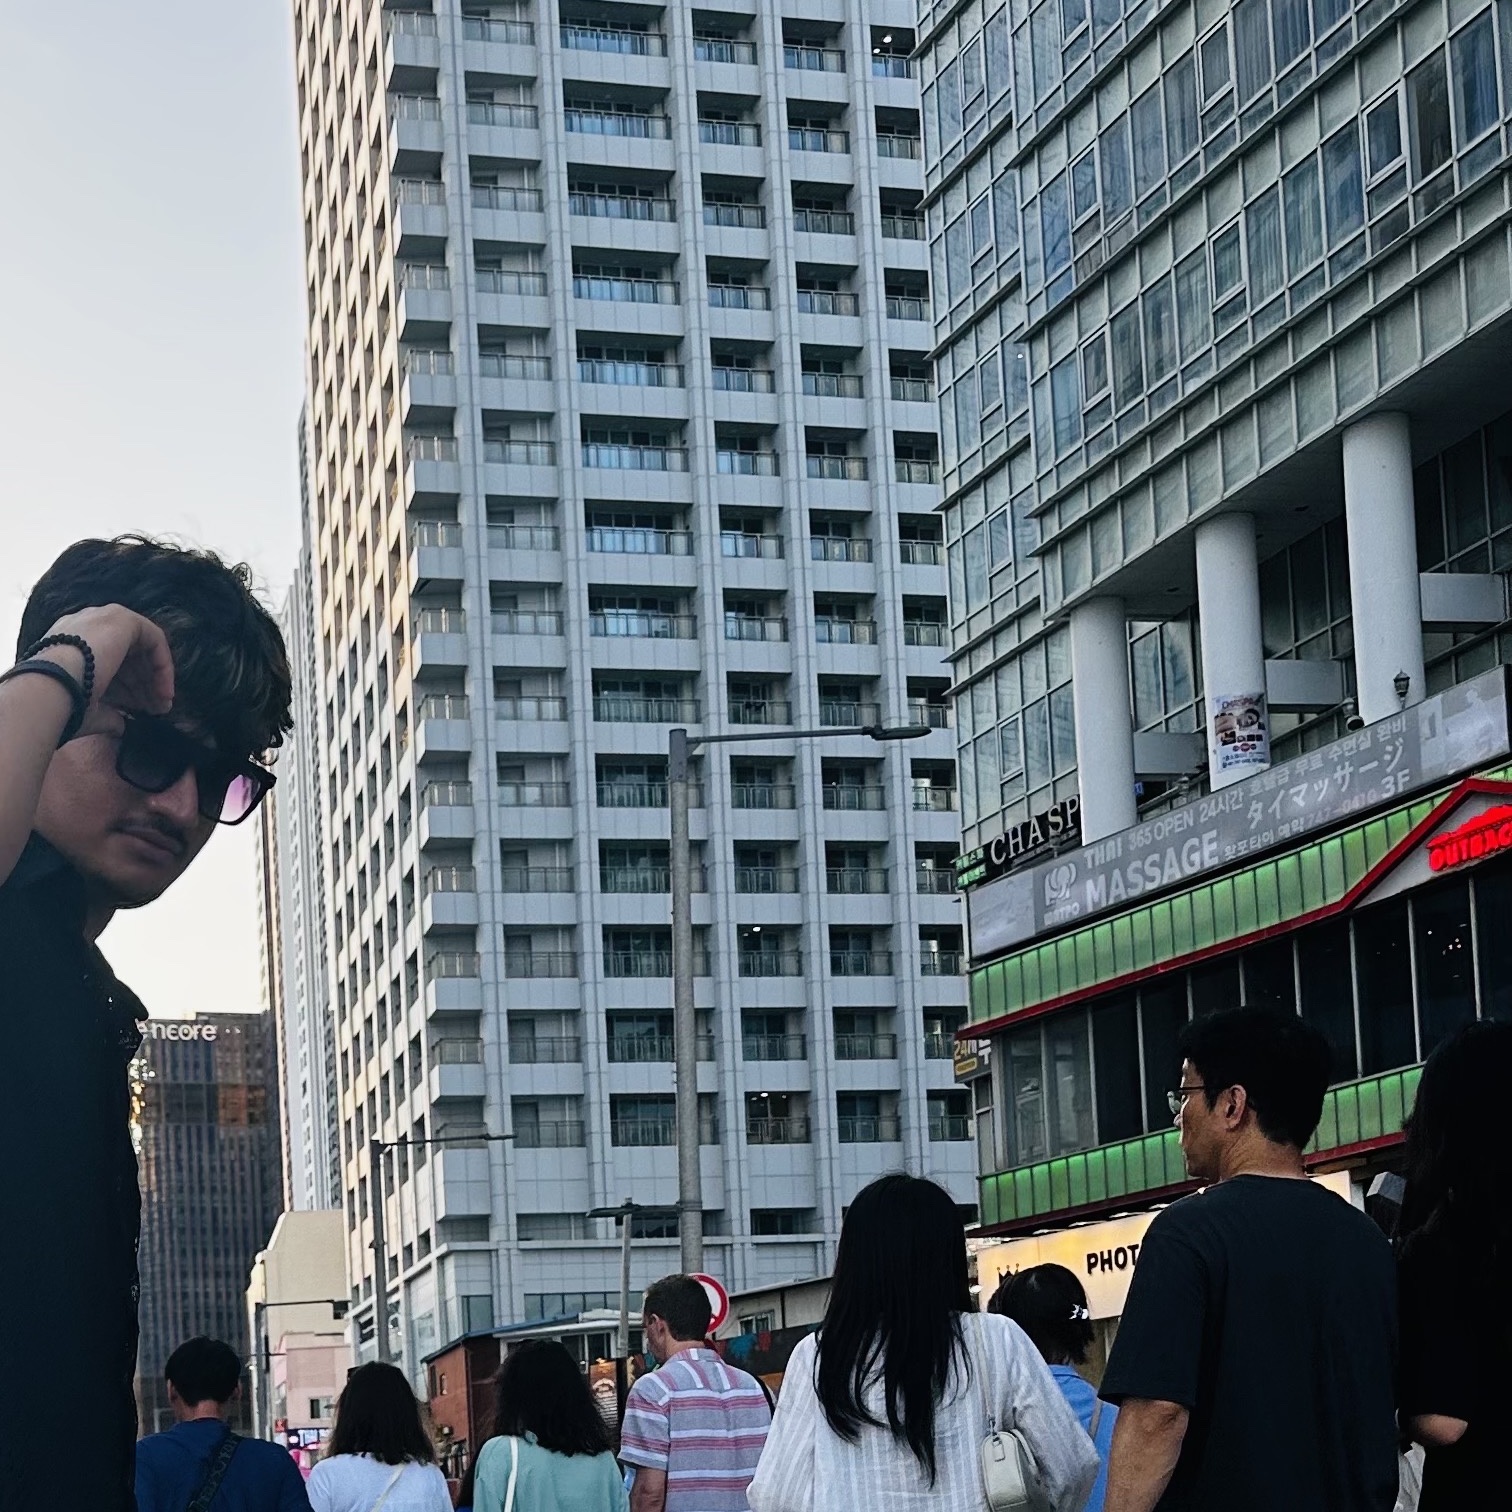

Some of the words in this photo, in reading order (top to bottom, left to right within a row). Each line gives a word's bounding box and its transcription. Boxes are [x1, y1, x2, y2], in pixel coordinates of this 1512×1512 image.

[1381, 768, 1410, 798] 3F
[990, 815, 1045, 865] CHA
[1084, 837, 1123, 870] THAI
[1129, 826, 1153, 851] 365
[1153, 808, 1195, 840] OPEN
[1086, 829, 1220, 911] MASSAGE
[1086, 1243, 1140, 1275] PHOT
